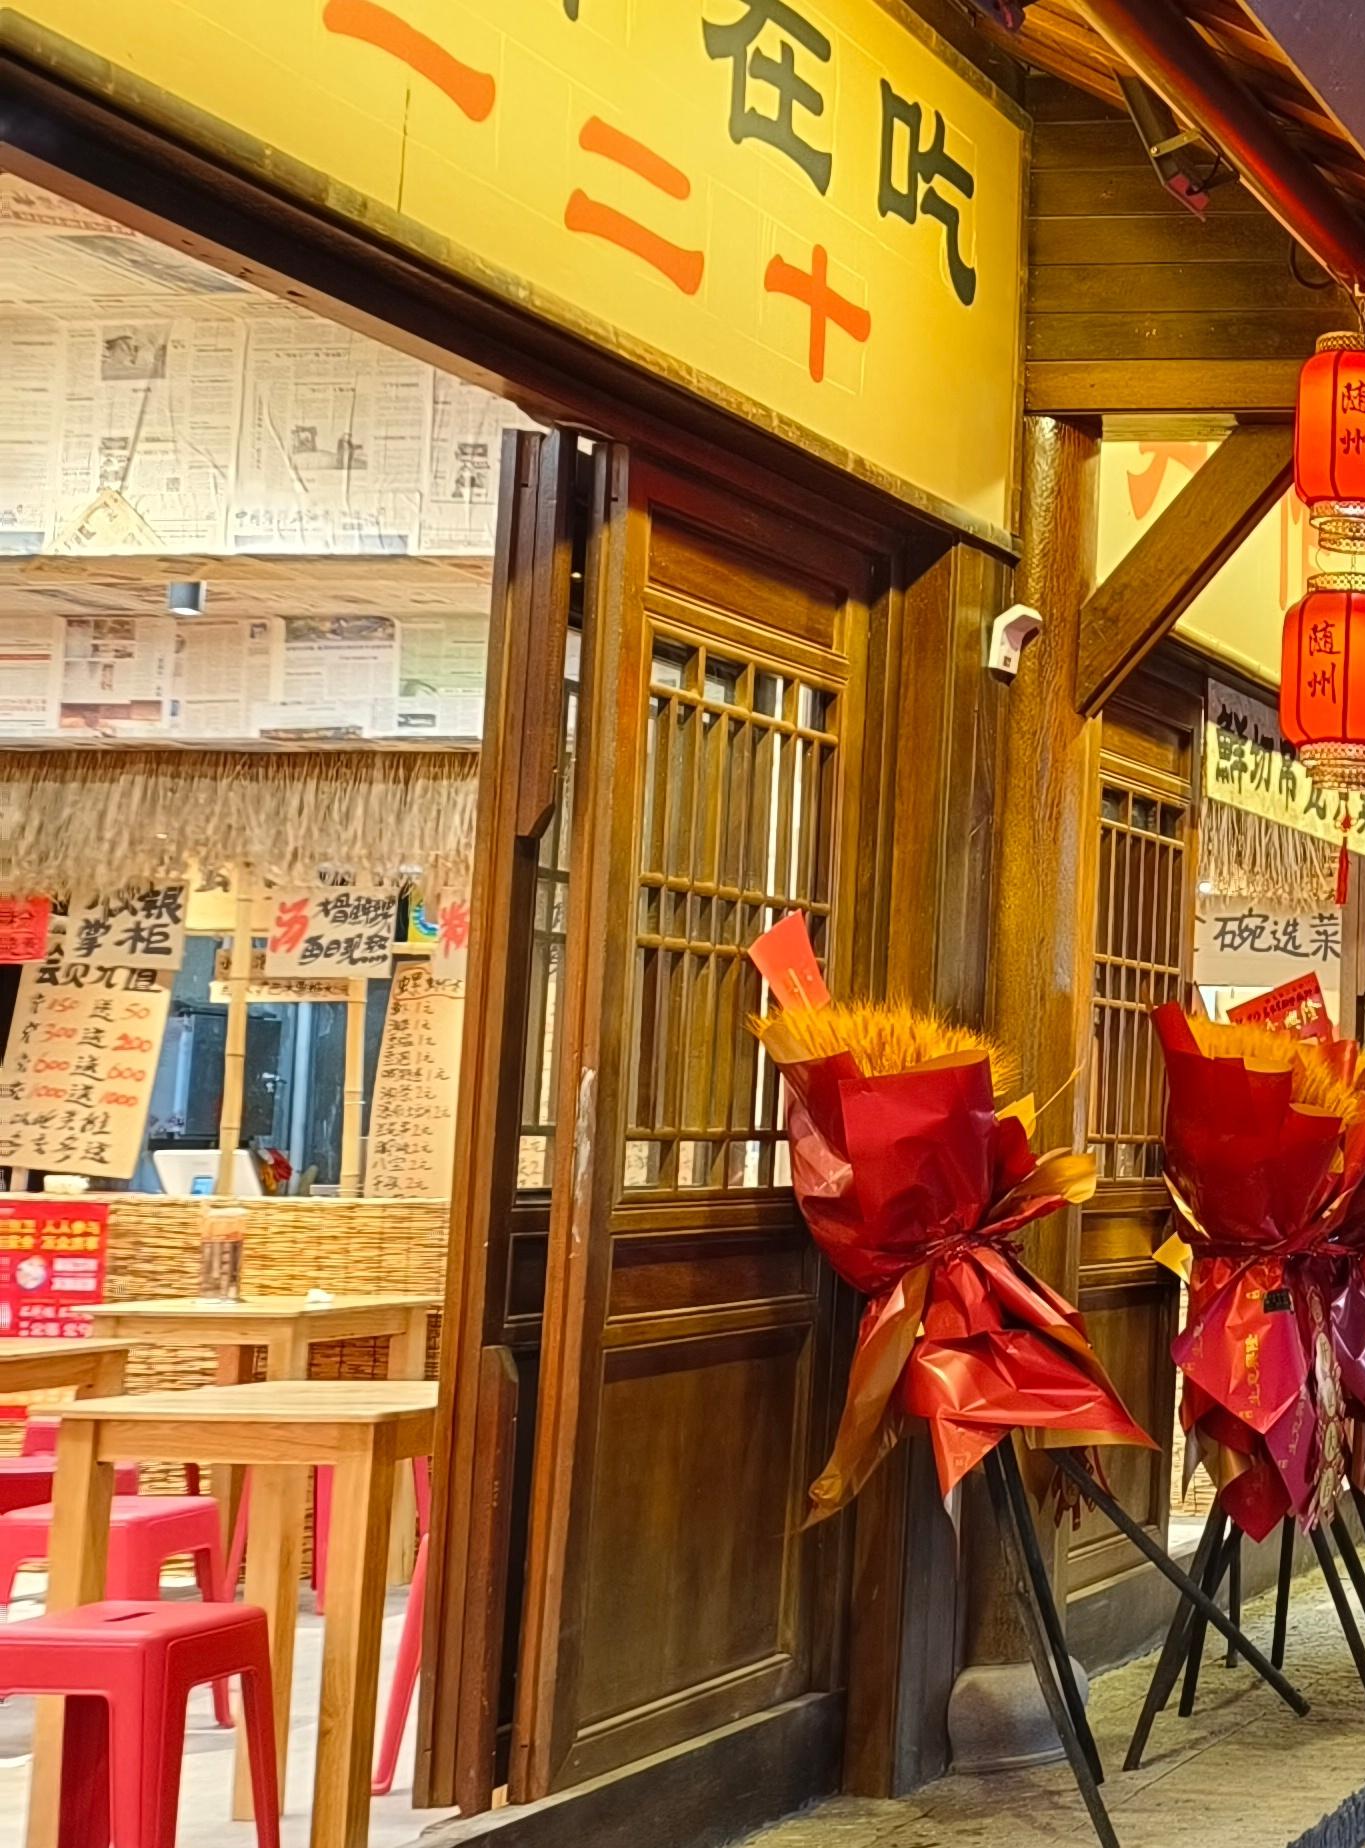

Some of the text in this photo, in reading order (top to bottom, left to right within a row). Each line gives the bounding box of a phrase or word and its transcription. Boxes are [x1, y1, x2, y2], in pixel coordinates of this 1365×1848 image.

[1307, 620, 1342, 704] 随州
[73, 919, 173, 957] 掌柜
[1194, 906, 1342, 962] 碗选菜
